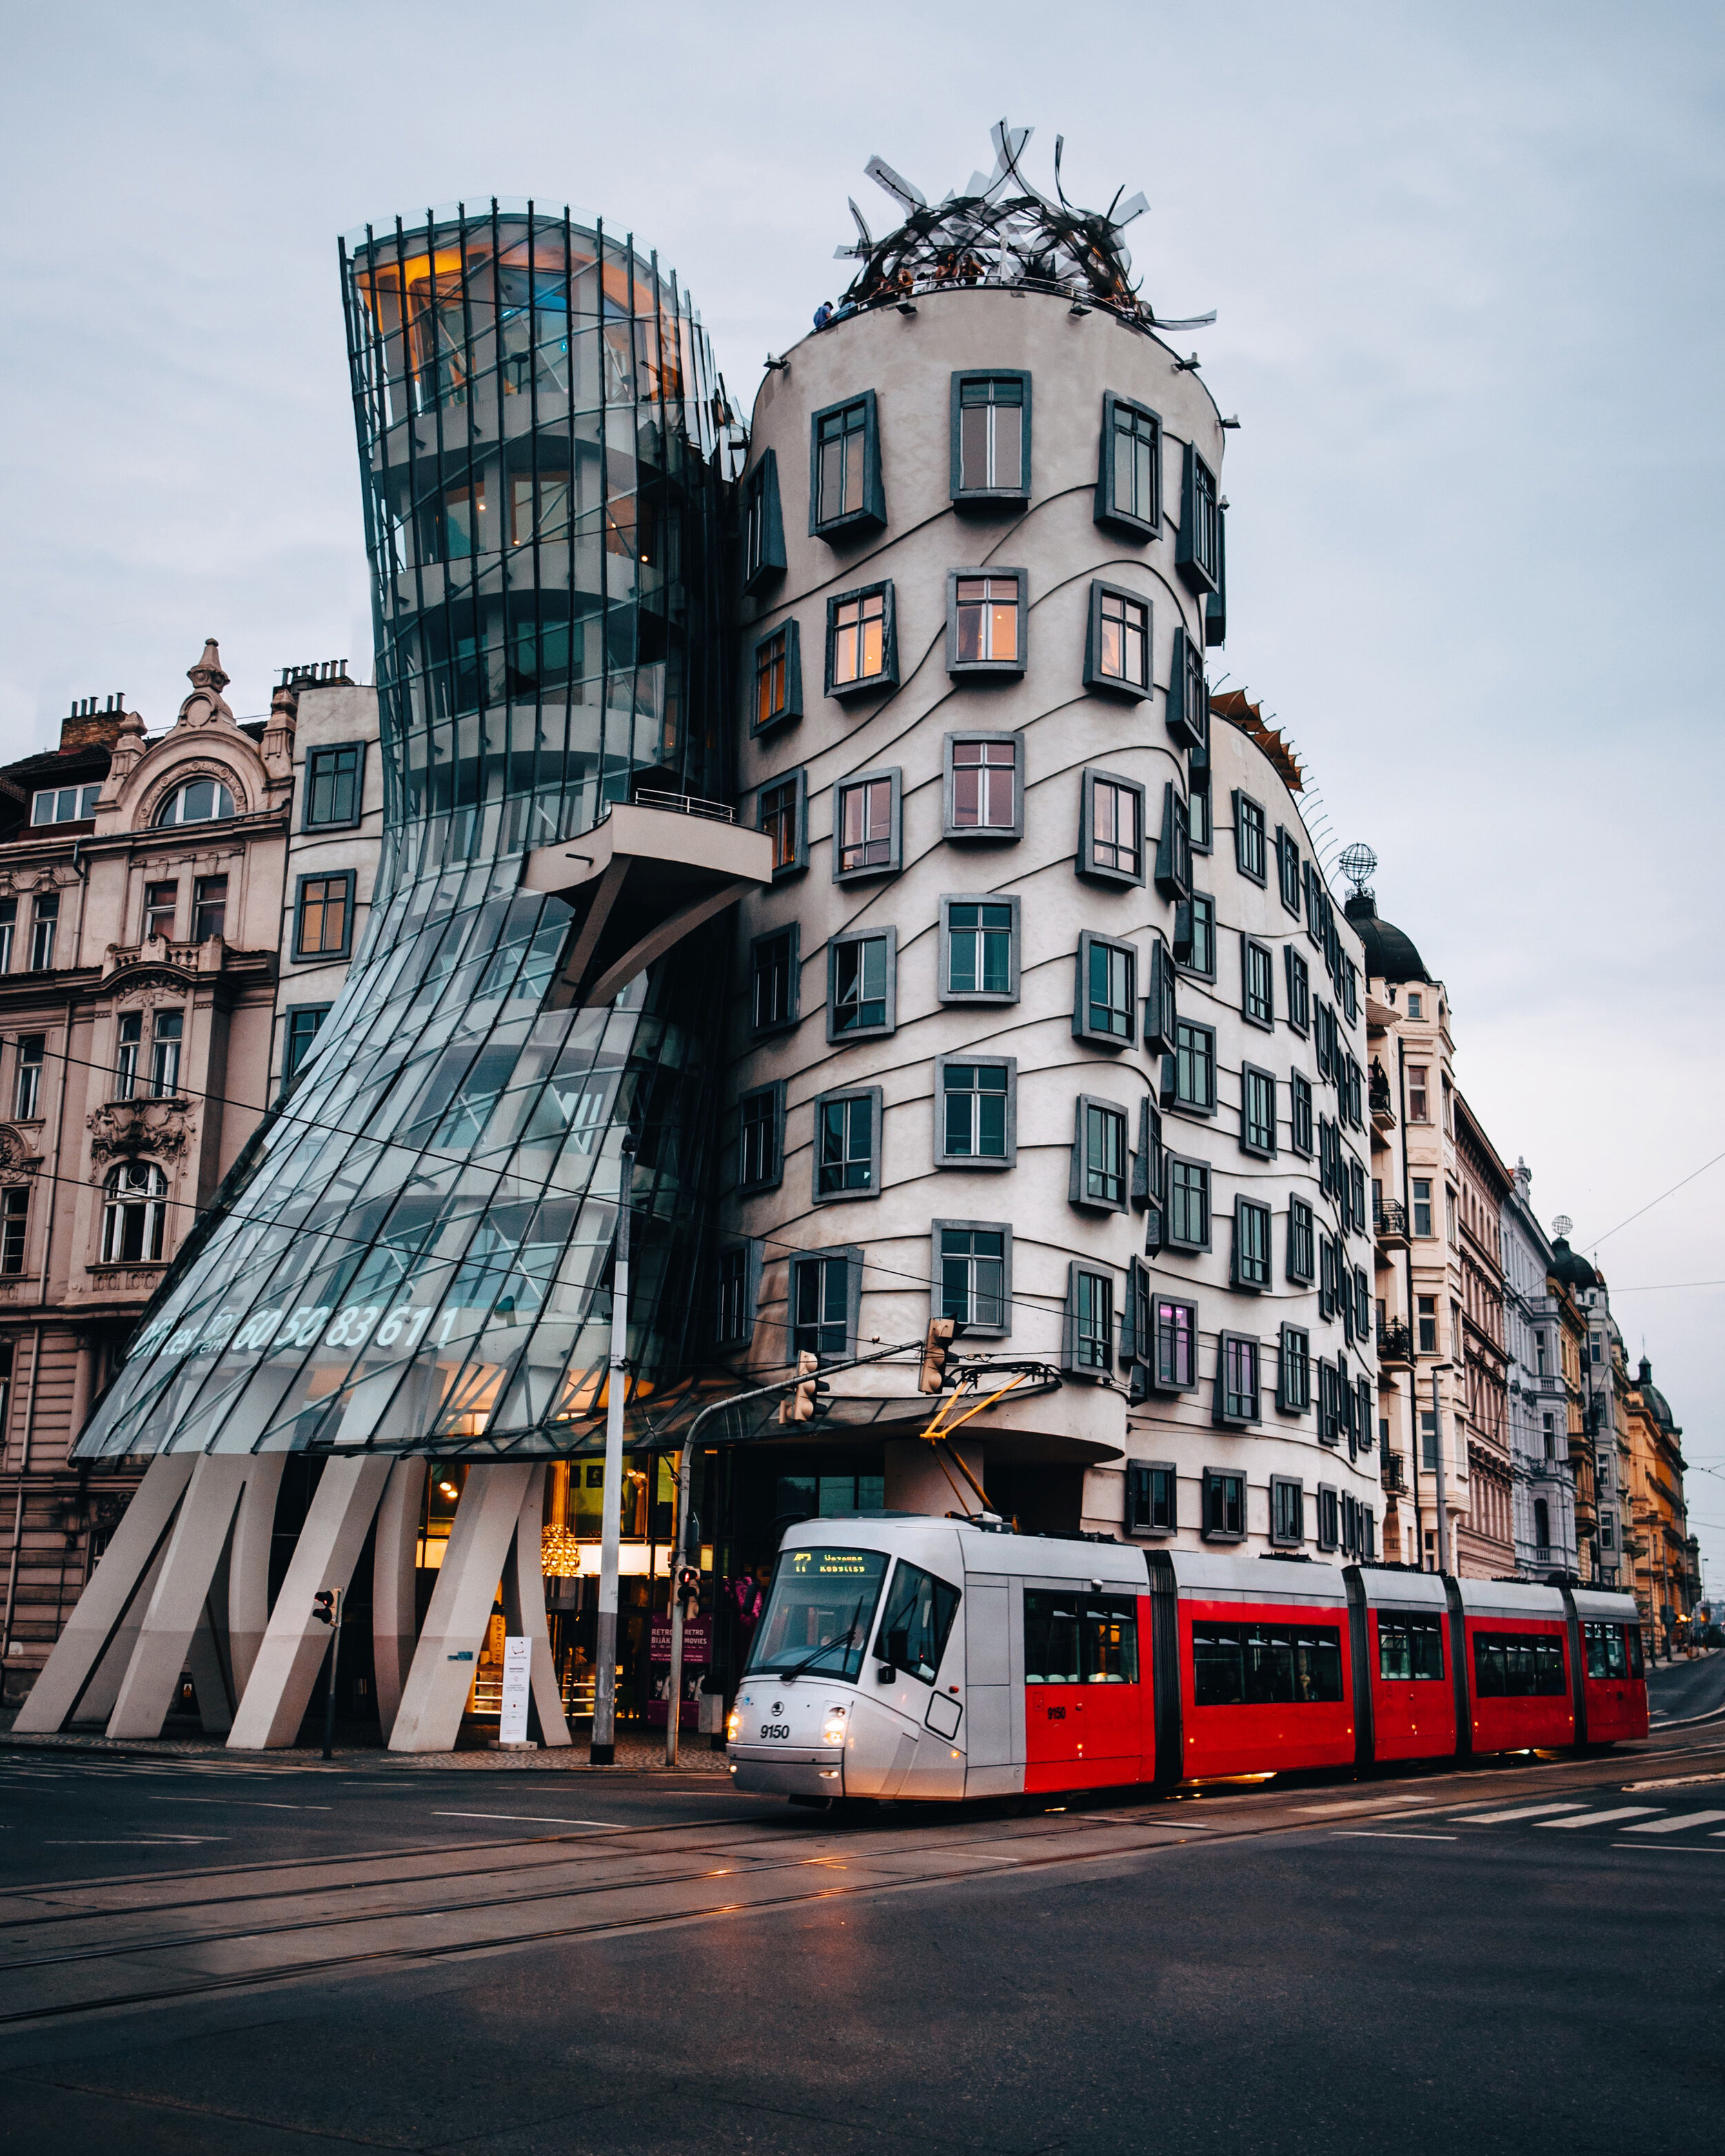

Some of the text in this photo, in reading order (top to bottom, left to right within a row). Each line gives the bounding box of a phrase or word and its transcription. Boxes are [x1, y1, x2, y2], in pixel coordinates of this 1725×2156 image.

[128, 1318, 201, 1359] Offces
[1047, 1707, 1066, 1720] 9150
[760, 1724, 789, 1739] 9150
